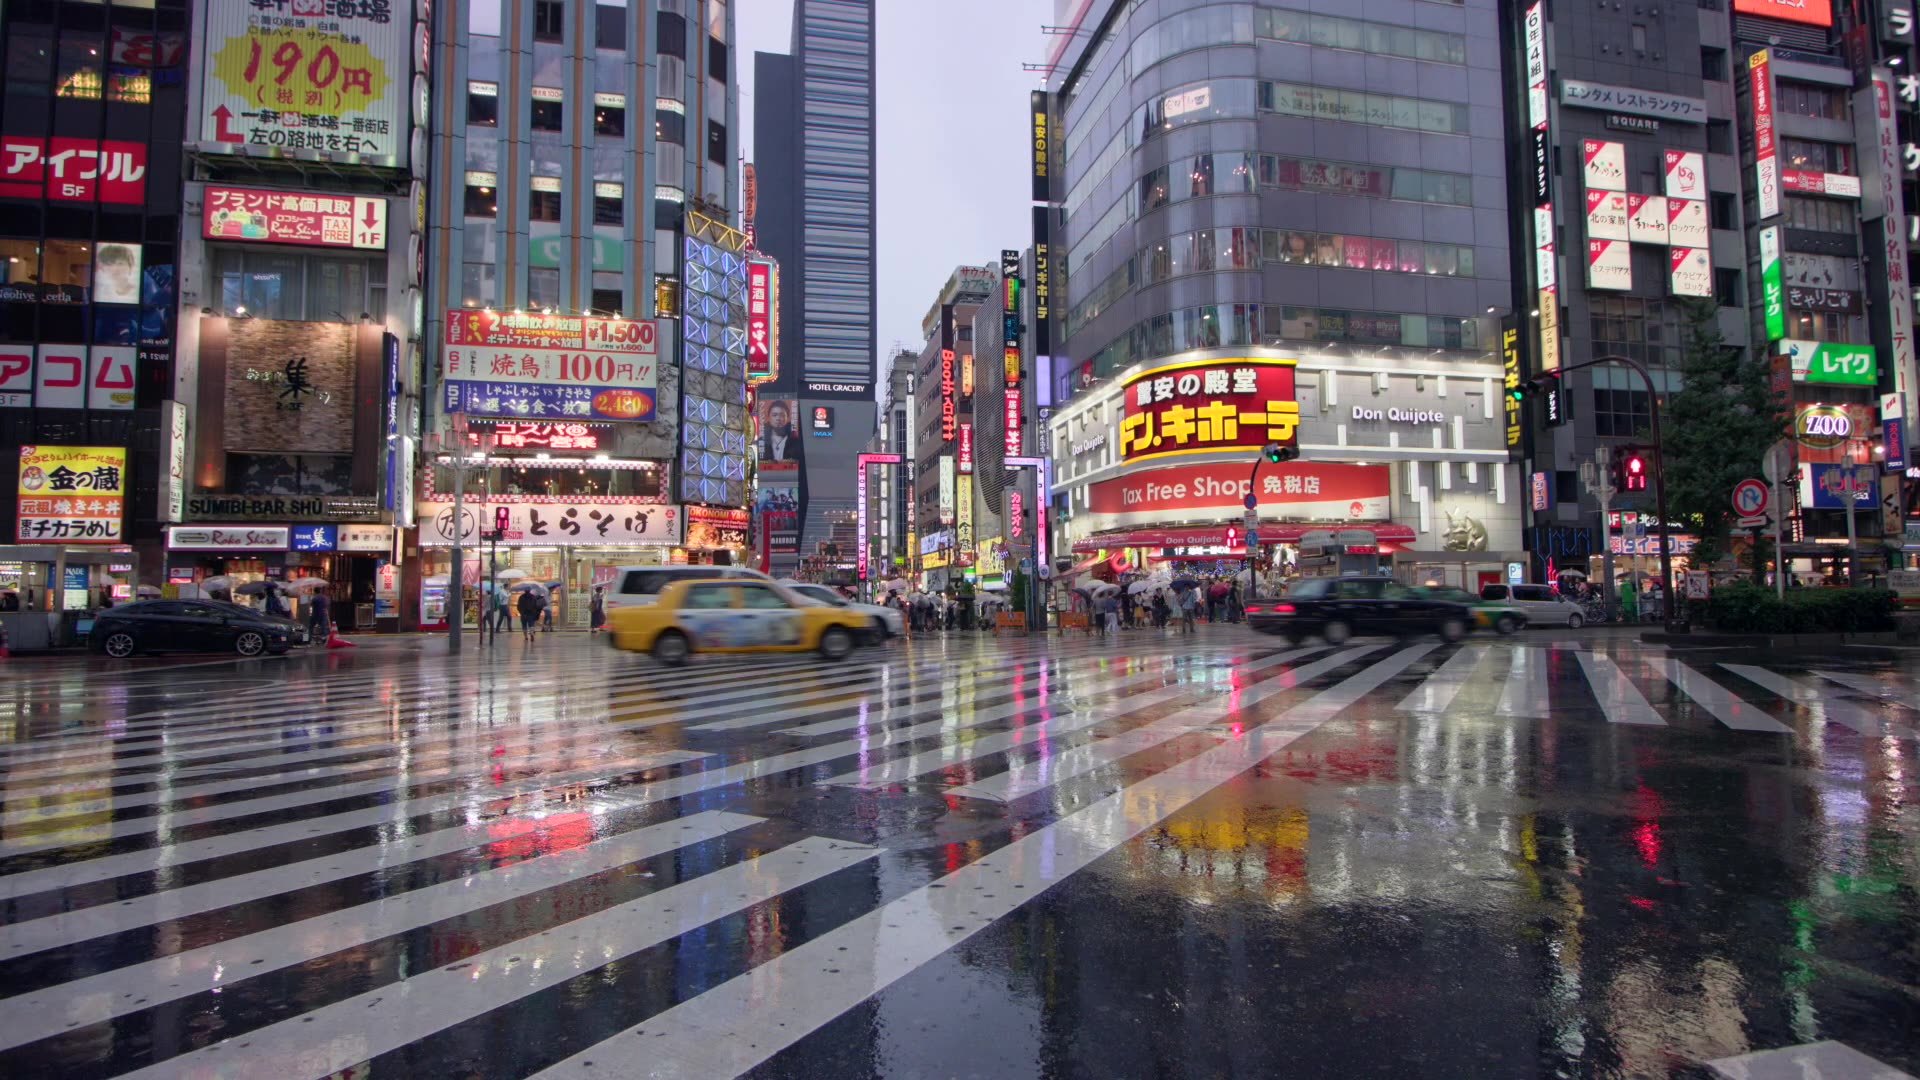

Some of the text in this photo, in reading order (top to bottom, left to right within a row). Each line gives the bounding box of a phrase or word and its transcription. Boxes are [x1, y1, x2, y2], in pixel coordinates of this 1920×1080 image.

[244, 37, 372, 95] 190円
[1568, 86, 1703, 114] エンタメ レストランタワー
[1612, 116, 1660, 130] SQUARE
[250, 127, 378, 153] 左の路地を右へ
[1586, 143, 1598, 152] 8F
[5, 143, 144, 184] アイフル
[1666, 154, 1678, 163] 9F
[62, 184, 85, 198] 5F
[1588, 193, 1600, 202] 4F
[211, 191, 351, 215] ブランド高価買取
[1629, 196, 1641, 207] 5F
[1669, 201, 1680, 211] 6F
[324, 218, 349, 230] TAX
[324, 230, 349, 242] FREE
[359, 232, 381, 245] 1F
[1672, 250, 1684, 260] 2F
[752, 274, 765, 314] 居酒屋
[1766, 282, 1780, 316] レイク
[1789, 288, 1840, 309] きゃりこ
[588, 325, 653, 345] ¥1,500
[490, 353, 540, 378] 焼鳥
[1822, 351, 1870, 375] レイク
[486, 384, 540, 397] しゃぶしゃぶ
[556, 387, 592, 400] すきやき
[809, 383, 865, 392] HOTEL GRACERY
[1137, 368, 1258, 406] 驚安の殿堂
[484, 397, 592, 416] 選べる食べ放題
[1352, 405, 1445, 425] Don Quijote
[1806, 415, 1849, 436] ZOO
[1072, 433, 1105, 457] Don Quijote
[1889, 422, 1900, 458] PROMISE
[48, 464, 119, 491] 金の蔵
[1122, 473, 1321, 505] Tax Free Shop 免税店
[22, 499, 120, 516] 元祖 焼き牛丼
[1011, 492, 1022, 538] カラオケ
[20, 519, 119, 538] 東京 チカラめし
[530, 507, 656, 537] とらそば
[1165, 536, 1223, 545] Don Quijote
